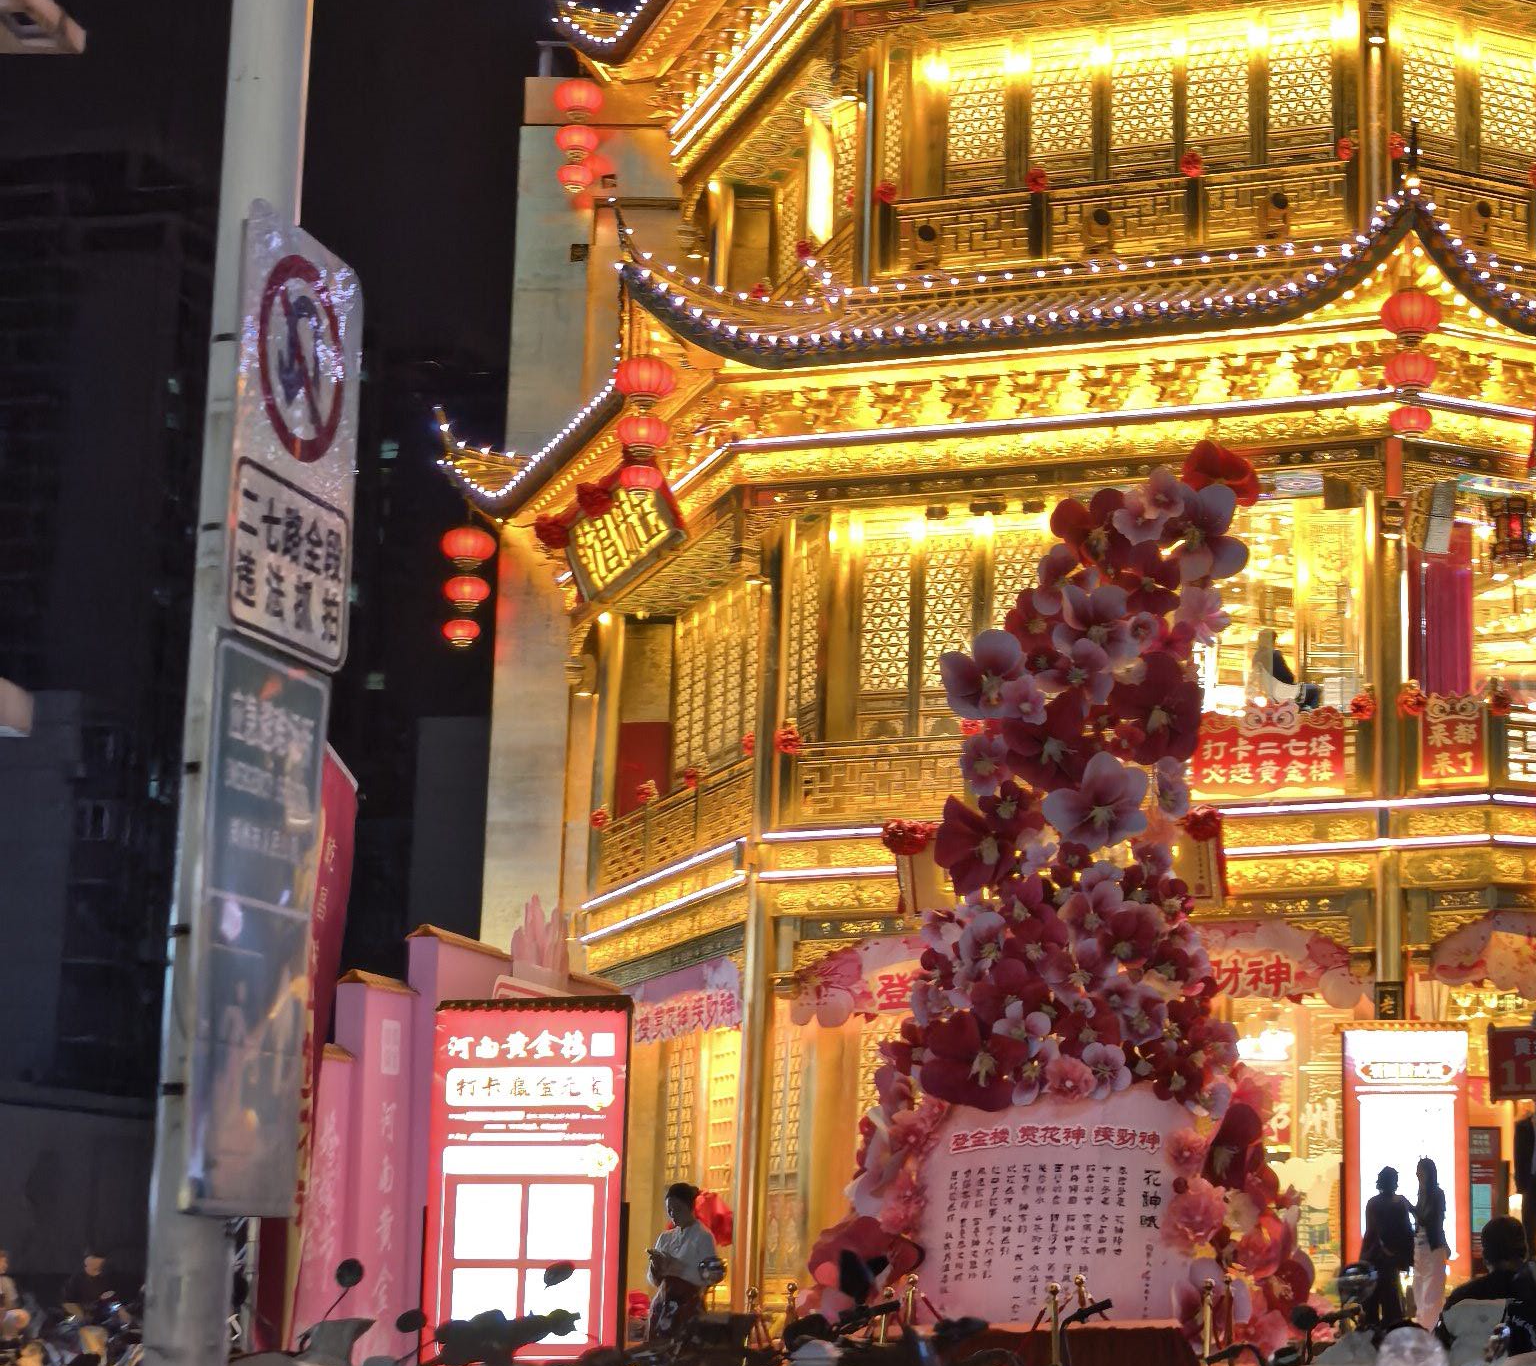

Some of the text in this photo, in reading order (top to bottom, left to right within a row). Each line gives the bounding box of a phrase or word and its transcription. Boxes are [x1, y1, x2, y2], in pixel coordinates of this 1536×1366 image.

[1202, 733, 1337, 761] 打卡二七塔
